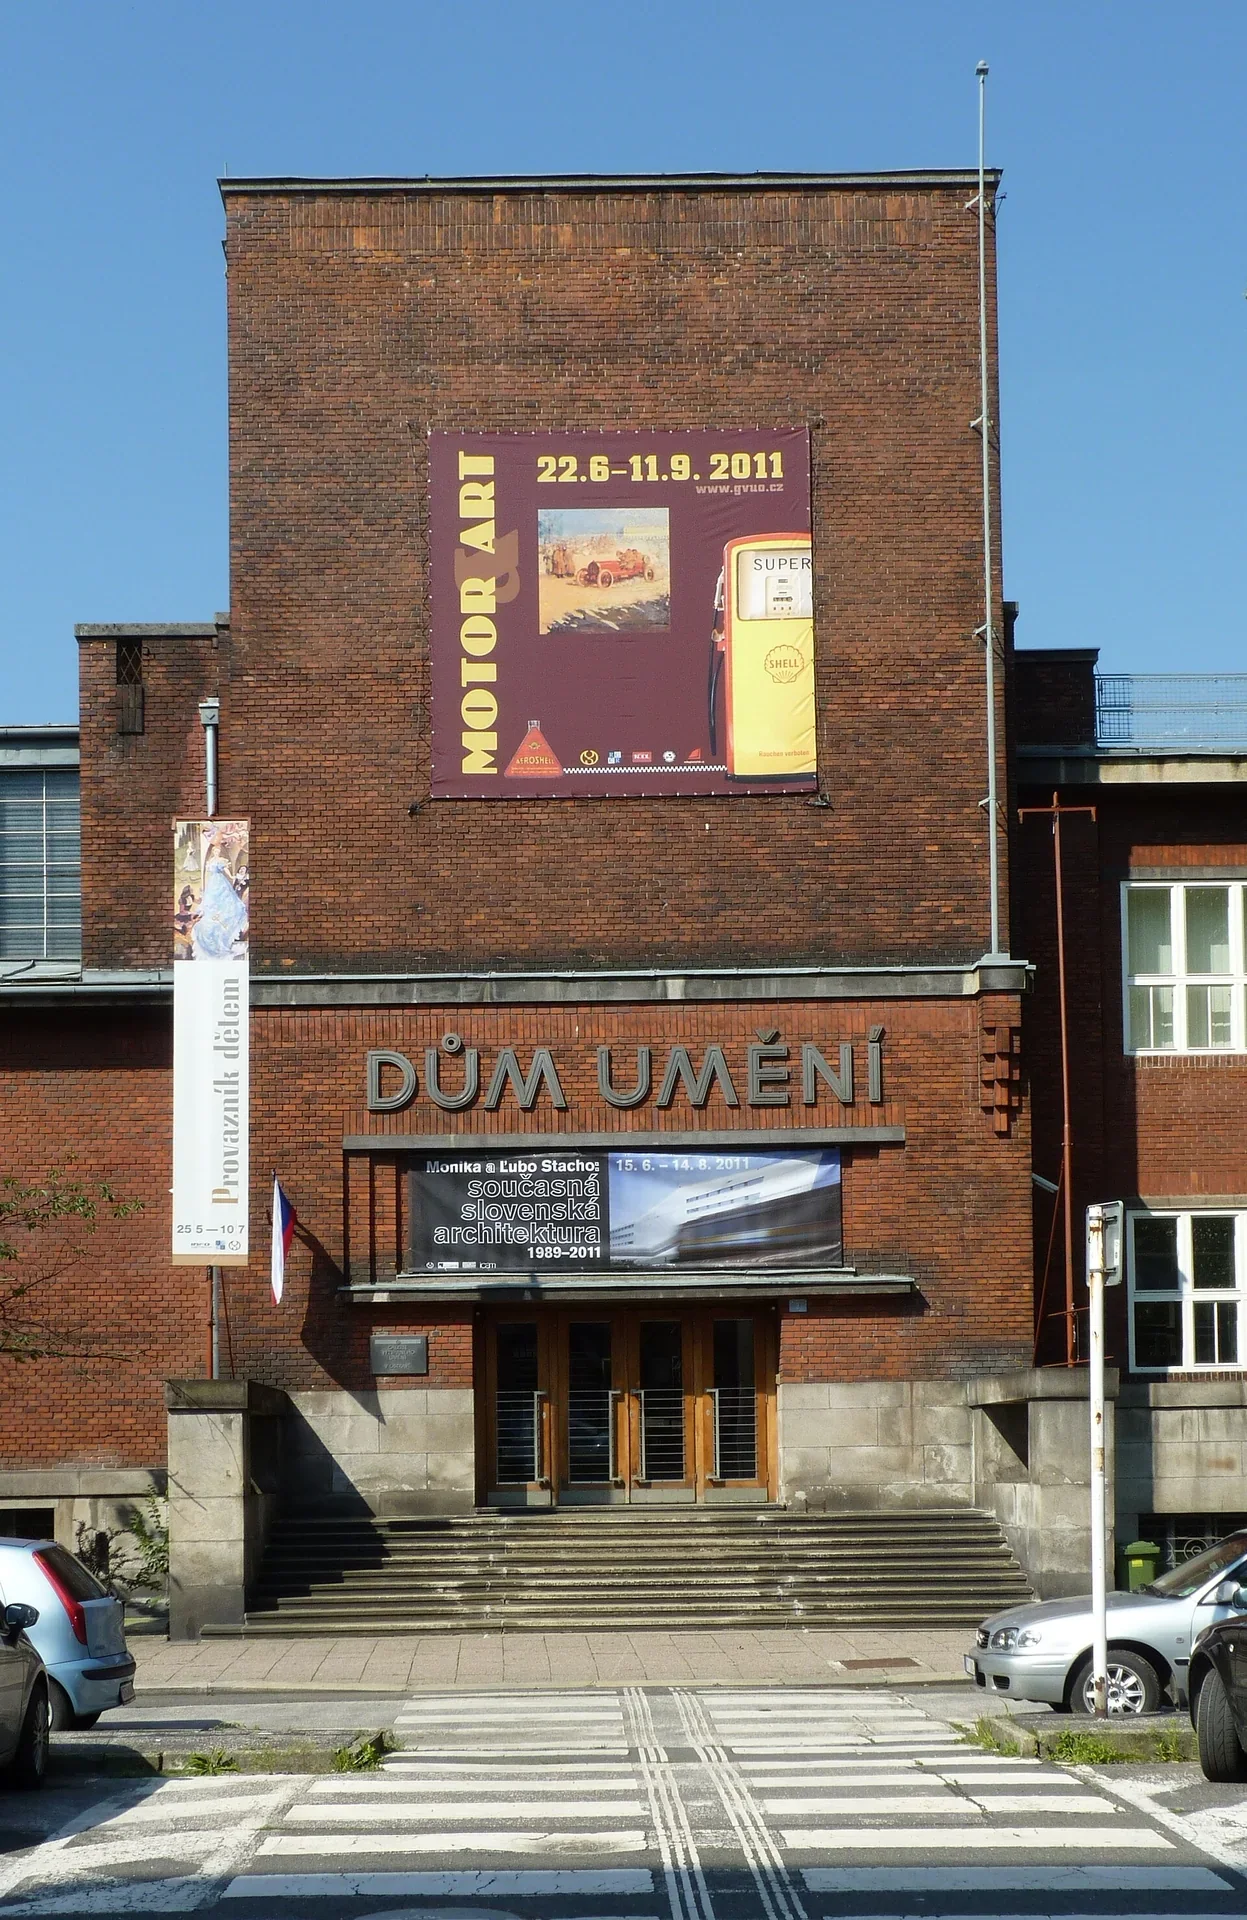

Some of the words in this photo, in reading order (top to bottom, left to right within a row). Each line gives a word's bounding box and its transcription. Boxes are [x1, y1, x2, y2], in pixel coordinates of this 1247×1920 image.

[709, 452, 783, 480] 2011
[696, 483, 784, 495] www.gvuo.cz
[459, 451, 495, 554] ART
[753, 557, 811, 571] SUPER
[460, 576, 498, 774] MOTOR
[769, 658, 799, 669] SHELL
[516, 756, 555, 765] AEROSHELL
[213, 978, 240, 1060] dětem
[367, 1033, 567, 1109] DŮM
[597, 1025, 883, 1106] UMĚNÍ
[212, 1070, 239, 1204] Provazník
[426, 1160, 482, 1173] Monika
[485, 1163, 496, 1173] a
[541, 1159, 600, 1172] Stacho:
[616, 1159, 637, 1172] 15.
[642, 1159, 655, 1171] 6.
[673, 1158, 694, 1171] 14.
[716, 1157, 750, 1170] 2011
[467, 1173, 600, 1198] současná
[460, 1197, 600, 1220] slovenská
[433, 1222, 601, 1244] architektura
